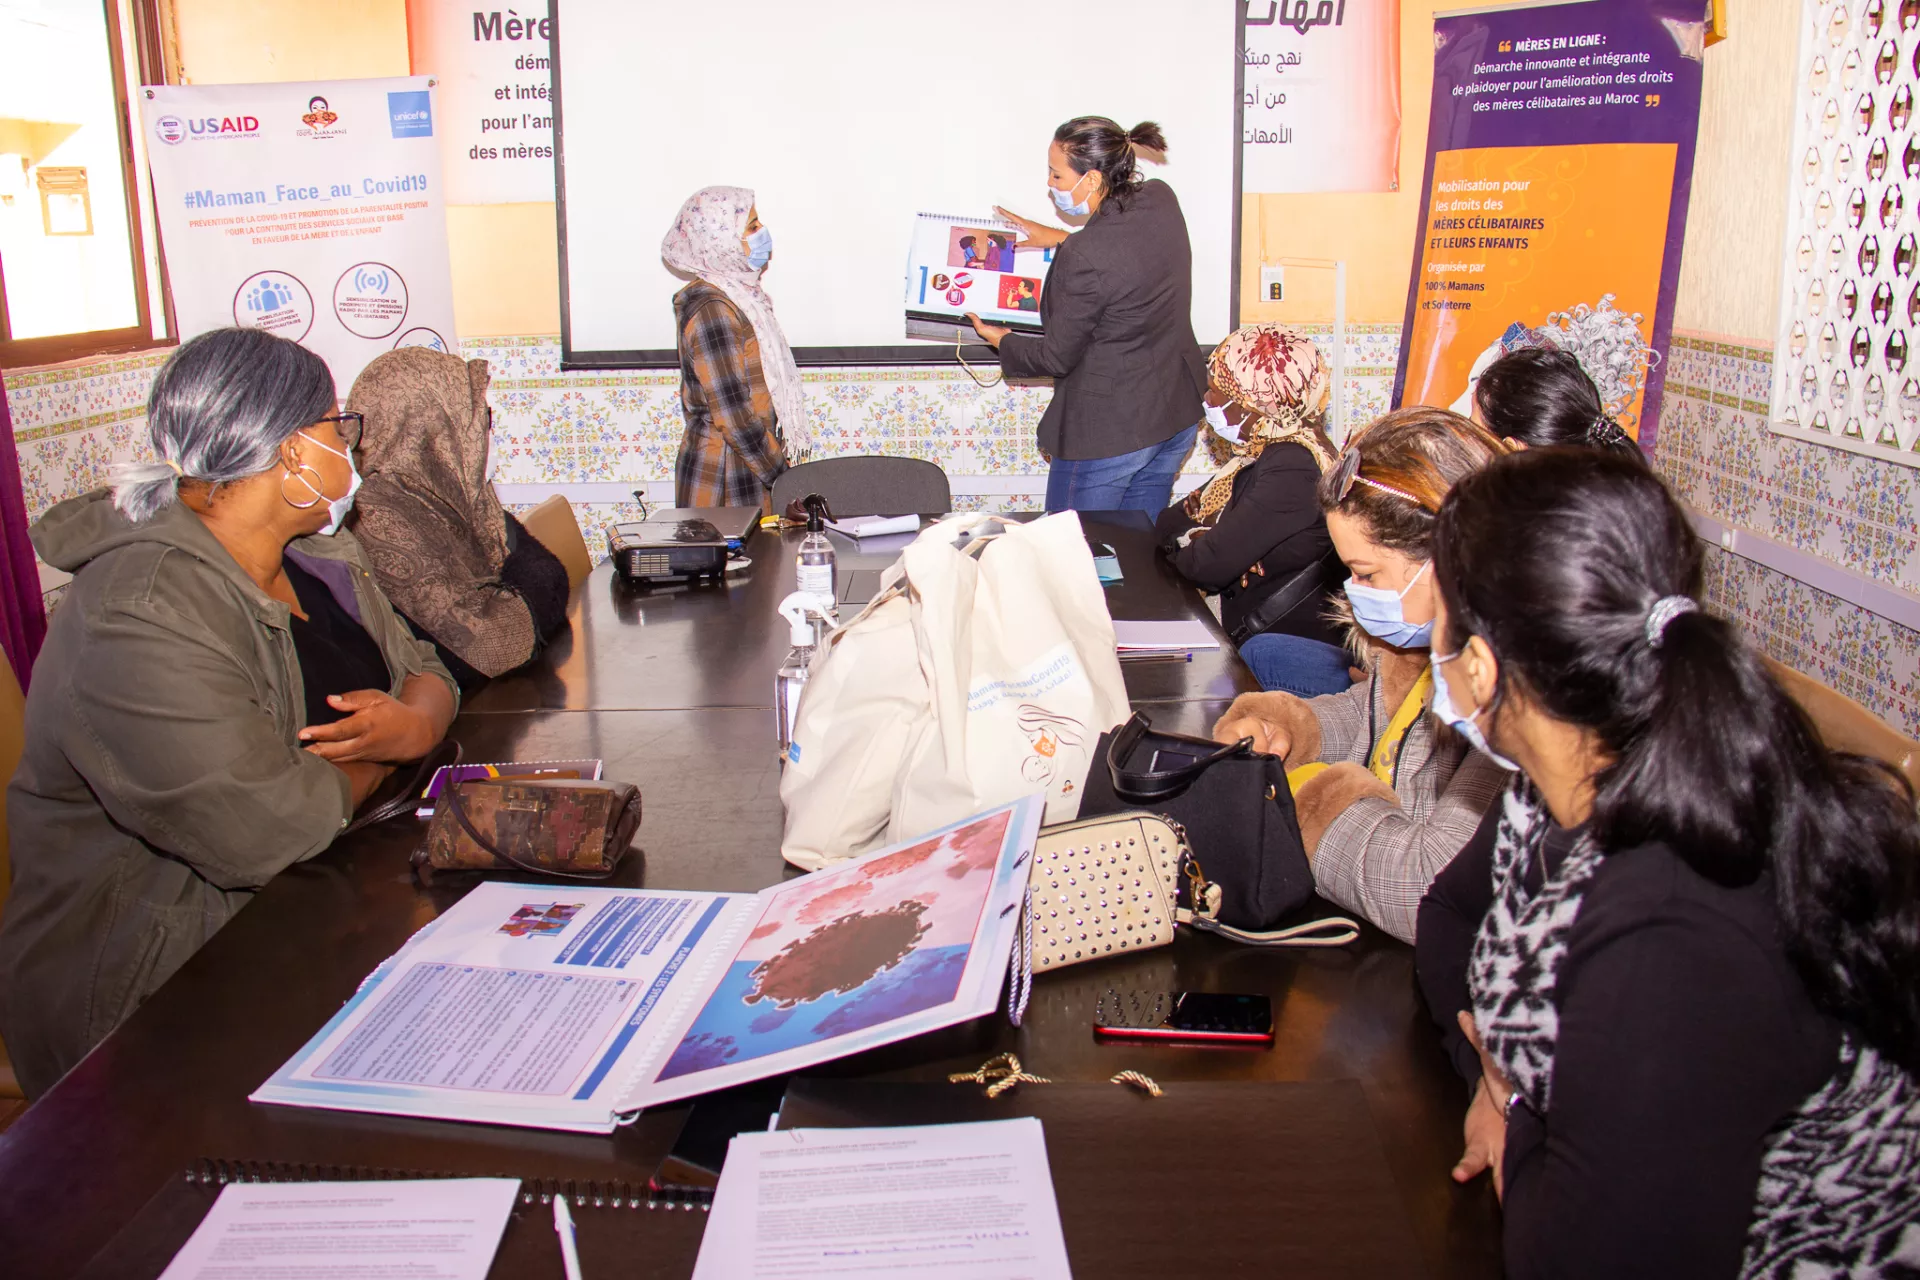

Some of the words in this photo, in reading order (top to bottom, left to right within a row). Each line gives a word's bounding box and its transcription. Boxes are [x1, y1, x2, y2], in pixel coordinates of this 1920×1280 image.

[473, 9, 550, 41] Mère
[1515, 36, 1550, 53] MÈRES
[1553, 36, 1566, 49] EN
[1276, 51, 1302, 73] نهج
[1474, 60, 1523, 75] Démarche
[1525, 56, 1576, 71] innovante
[1579, 55, 1590, 67] et
[1592, 50, 1650, 69] intégrante
[1452, 84, 1464, 96] de
[1465, 79, 1511, 97] plaidoyer
[1513, 79, 1538, 93] pour
[1615, 71, 1636, 84] des
[1639, 70, 1674, 83] droits
[494, 85, 511, 100] et
[1265, 93, 1286, 109] من
[1473, 99, 1490, 112] des
[1492, 97, 1523, 111] mères
[1526, 93, 1586, 109] célibataires
[1588, 95, 1601, 105] au
[1604, 93, 1640, 104] Maroc
[394, 110, 419, 121] unicef
[188, 116, 259, 134] USAID
[482, 118, 518, 133] pour
[1242, 122, 1292, 144] الأمهات
[469, 145, 498, 160] des
[503, 142, 553, 159] mères
[184, 174, 427, 209] #Maman_Face_au_Covid19
[1437, 178, 1500, 193] Mobilisation
[1502, 180, 1530, 193] pour
[236, 216, 245, 224] DE
[256, 213, 288, 222] COVID-19
[288, 212, 297, 220] ET
[298, 208, 339, 218] PROMOTION
[340, 207, 349, 215] DE
[404, 200, 429, 209] POSITIVE
[1435, 199, 1448, 212] les
[1450, 197, 1481, 211] droits
[1483, 197, 1503, 211] des
[225, 228, 245, 236] POUR
[298, 222, 312, 230] DES
[313, 218, 345, 228] SERVICES
[346, 216, 376, 225] SOCIAUX
[387, 213, 405, 221] BASE
[1433, 216, 1466, 230] MÈRES
[1467, 215, 1545, 230] CÉLIBATAIRES
[252, 237, 262, 245] EN
[263, 234, 290, 244] FAVEUR
[291, 233, 300, 241] DE
[301, 233, 310, 241] LA
[1430, 238, 1442, 249] ET
[1443, 237, 1476, 249] LEURS
[1478, 237, 1529, 249] ENFANTS
[1427, 262, 1468, 275] Organisée
[1469, 262, 1485, 274] par
[1425, 281, 1447, 291] 100%
[1447, 280, 1485, 292] Mamans
[1422, 301, 1430, 310] et
[1431, 300, 1472, 311] Soleterre
[257, 309, 295, 321] MOBILISATION
[263, 313, 299, 326] ENGAGEMENT
